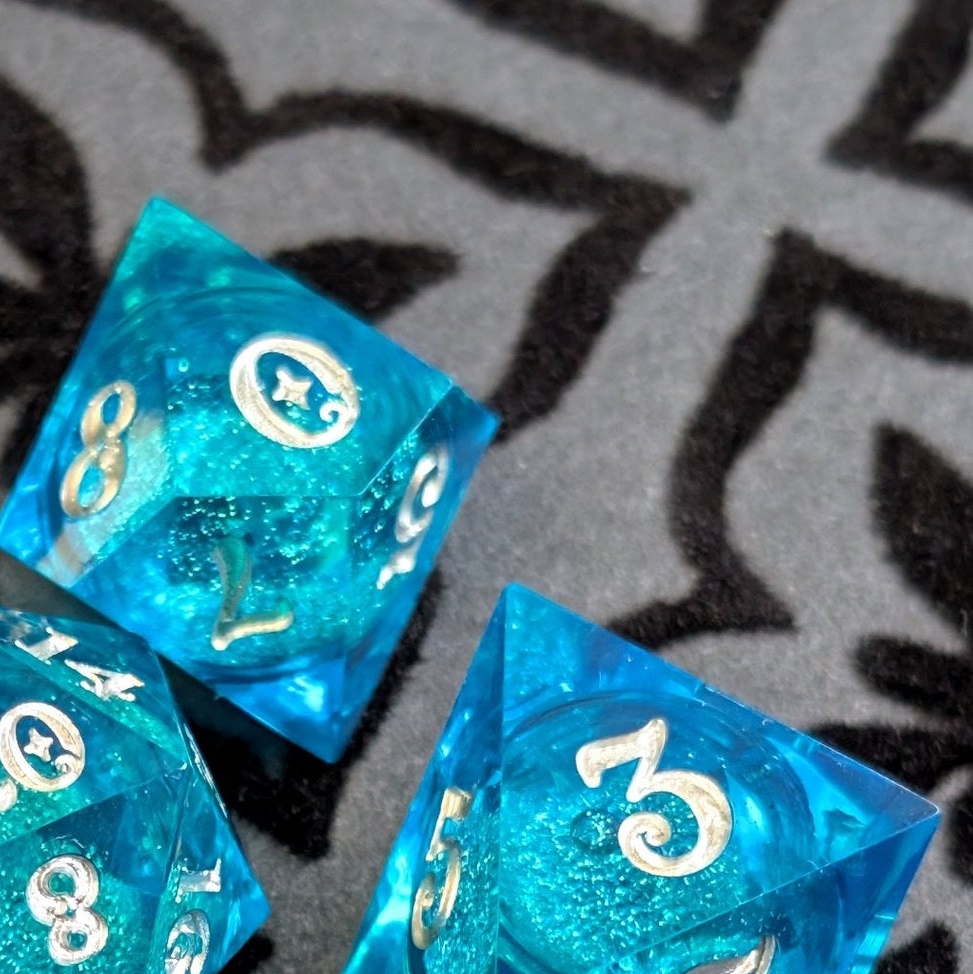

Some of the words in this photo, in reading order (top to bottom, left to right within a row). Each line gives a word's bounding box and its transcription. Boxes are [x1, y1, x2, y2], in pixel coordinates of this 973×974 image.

[60, 380, 136, 518] 8
[229, 332, 360, 449] 0
[377, 445, 450, 591] 5
[211, 534, 295, 651] 7
[14, 626, 145, 702] 14
[575, 718, 733, 878] 3
[27, 854, 109, 966] 8
[411, 787, 474, 951] 5
